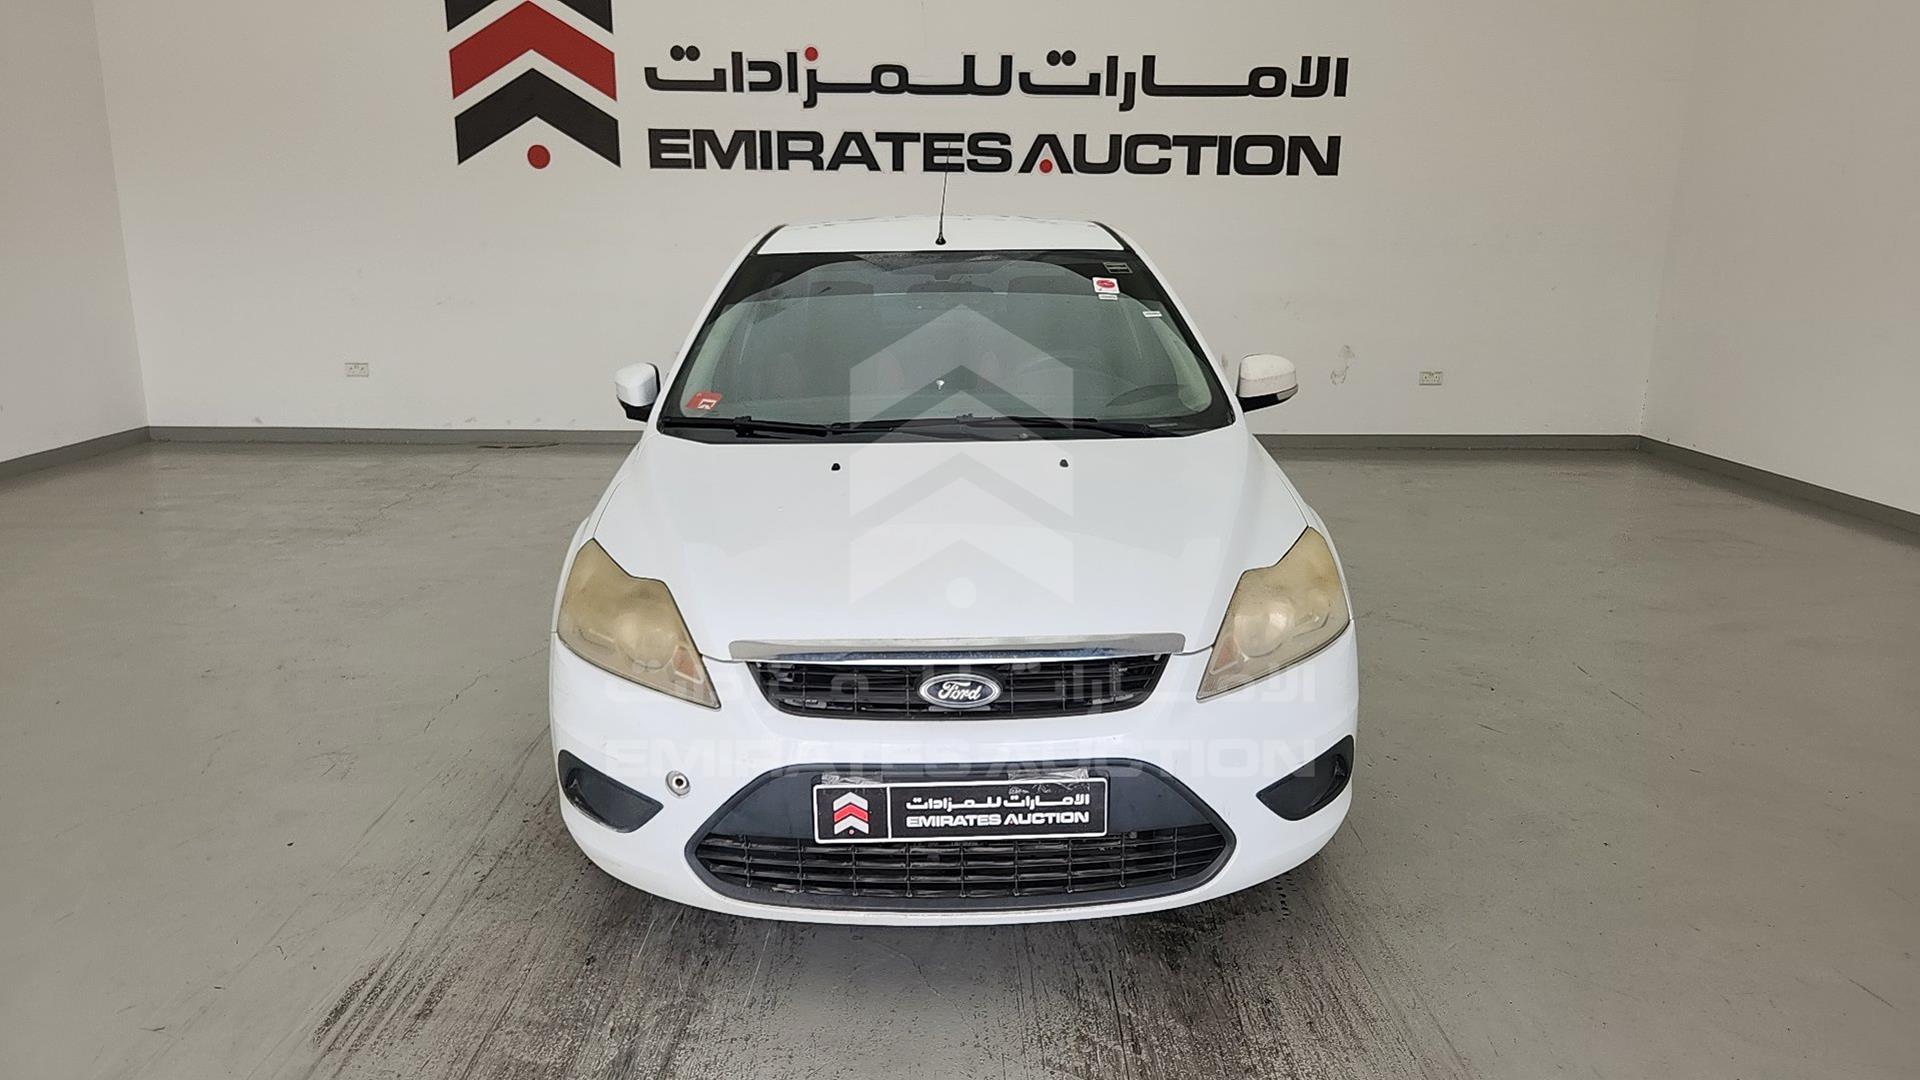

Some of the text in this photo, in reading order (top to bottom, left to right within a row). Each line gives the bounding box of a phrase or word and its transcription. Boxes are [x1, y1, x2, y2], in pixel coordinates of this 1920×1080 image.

[644, 45, 1013, 109] للمزادات
[648, 128, 1341, 176] EMIRATES AUCTION
[938, 681, 982, 700] Ford
[906, 796, 1002, 812] للمزادات
[906, 811, 1090, 828] EMIRATES AUCTION
